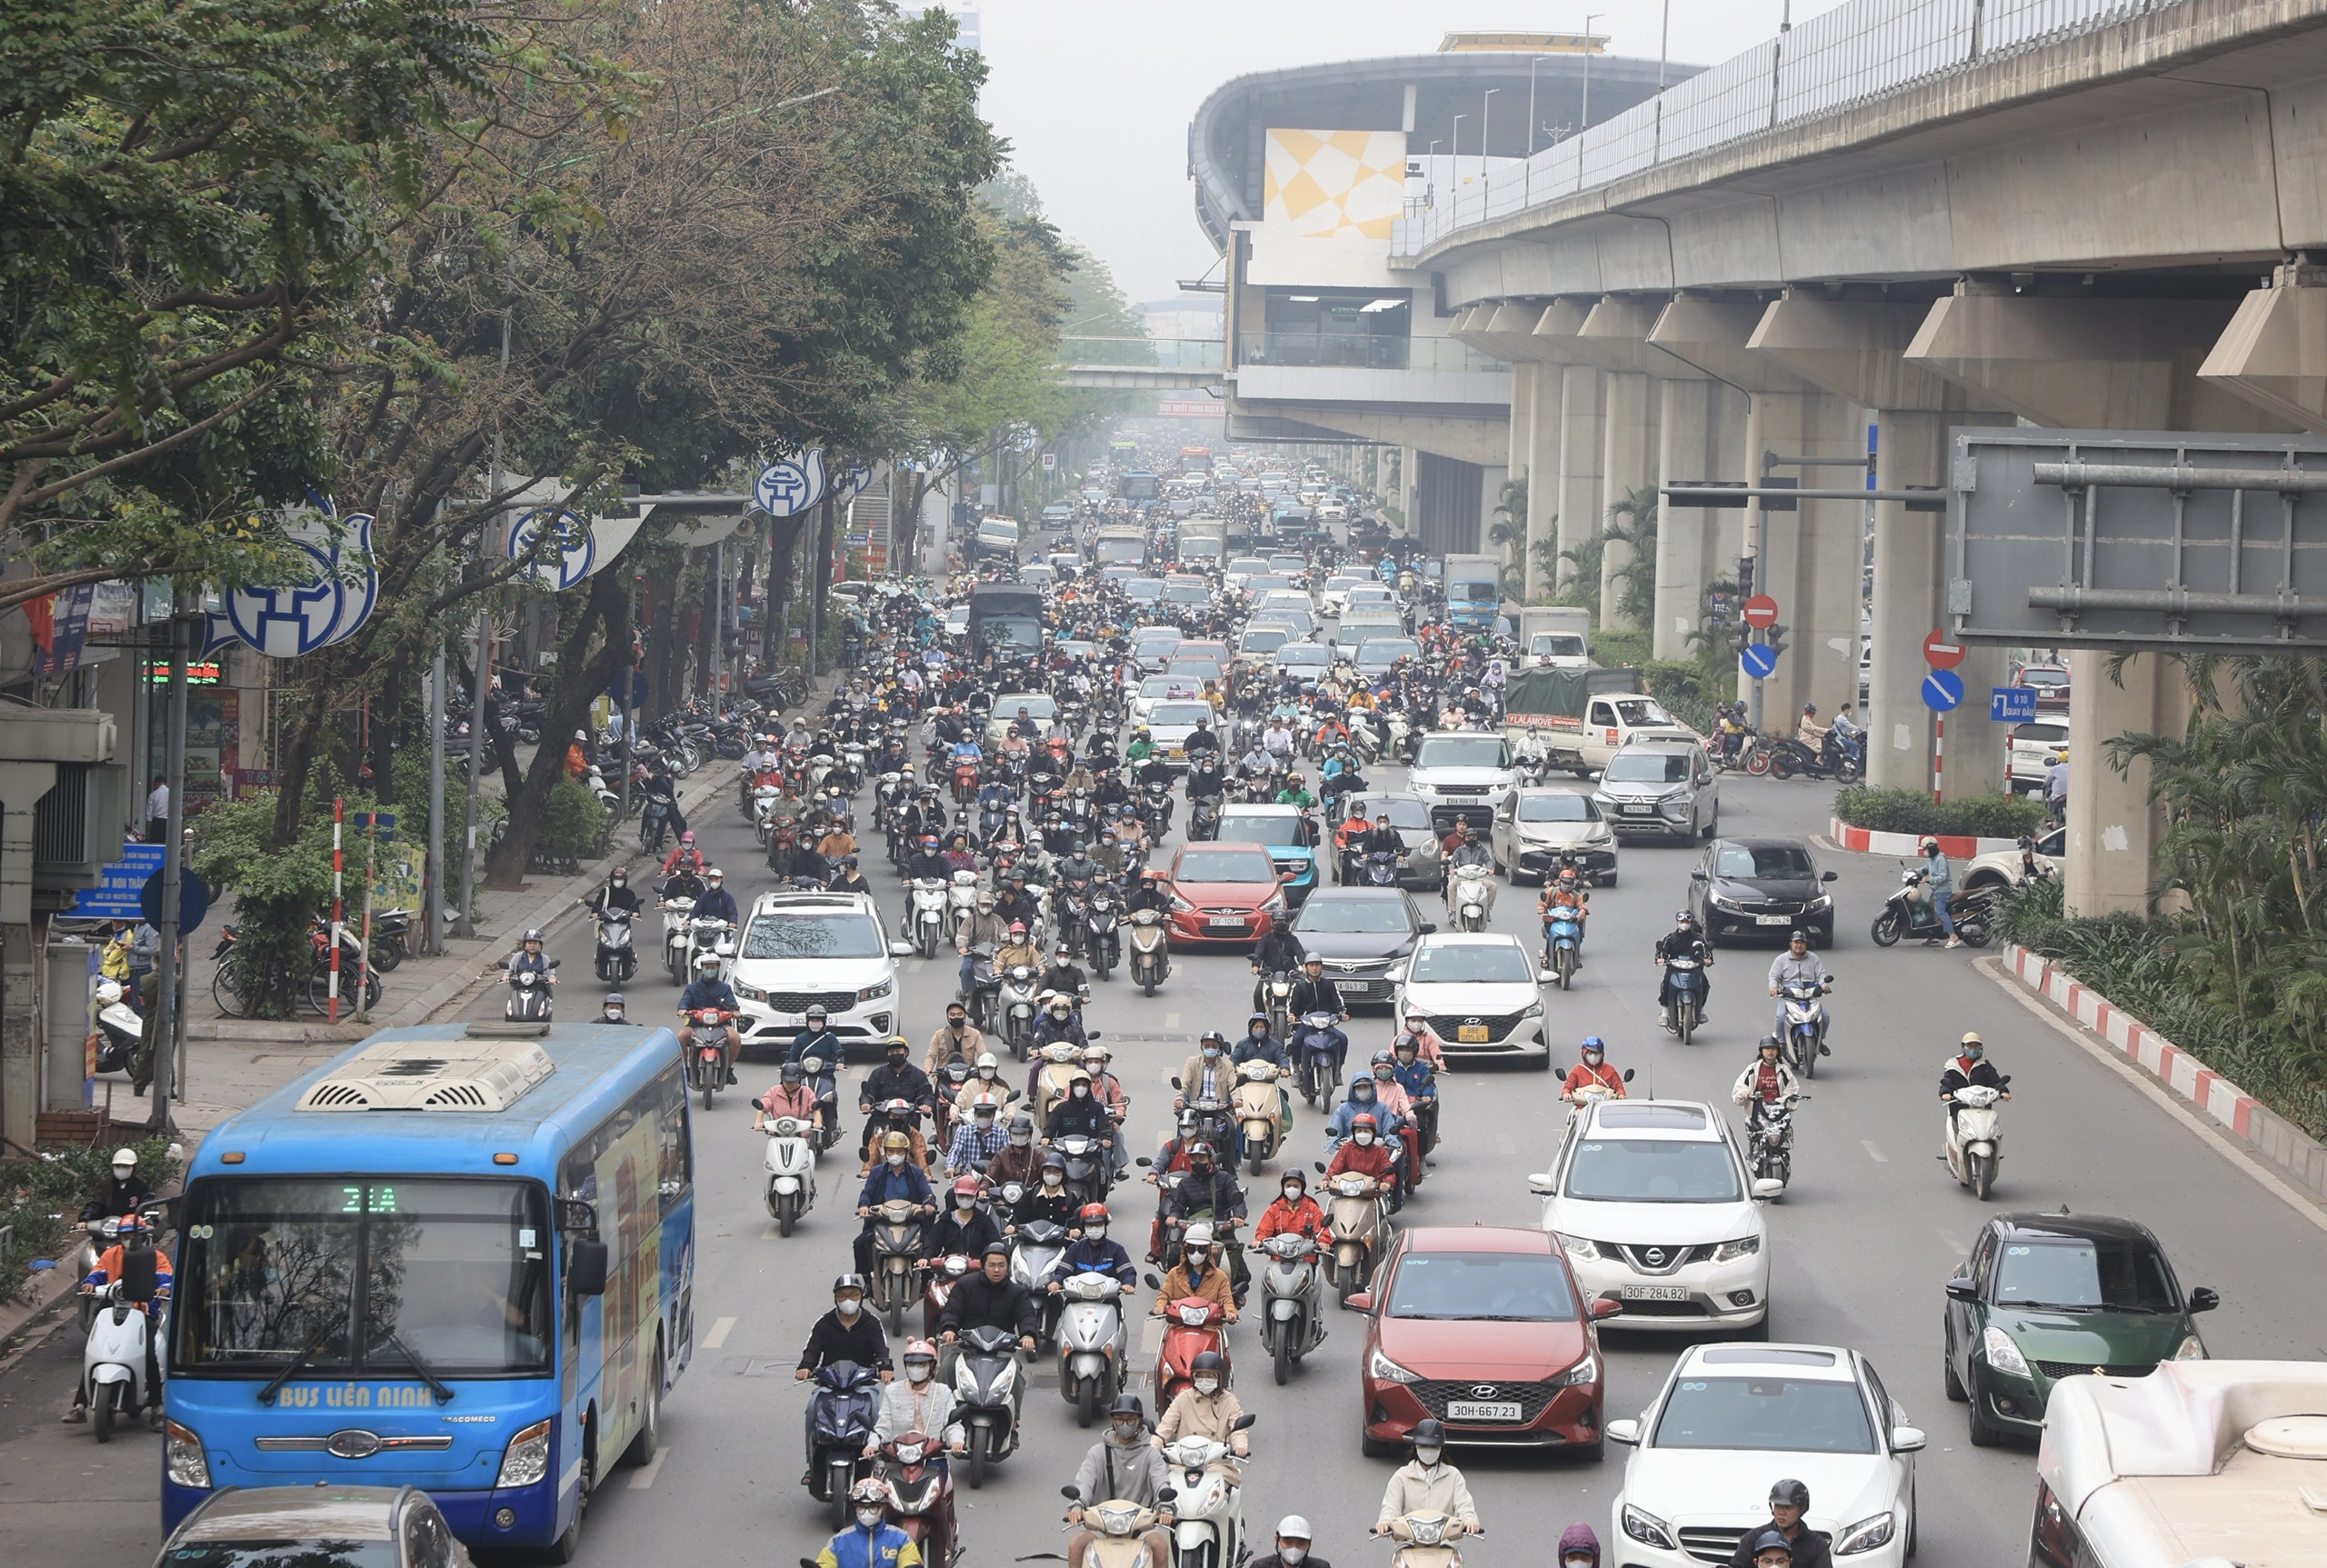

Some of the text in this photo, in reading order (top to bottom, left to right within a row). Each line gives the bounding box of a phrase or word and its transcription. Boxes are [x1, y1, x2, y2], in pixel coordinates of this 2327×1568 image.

[2014, 694, 2028, 704] Ô TÔ
[2006, 704, 2034, 716] QUAY ĐẦU
[1513, 714, 1553, 726] LALAMOVE
[245, 771, 255, 783] T
[257, 771, 267, 783] &
[112, 877, 126, 889] NON
[1627, 1286, 1683, 1300] 30F-284.82
[280, 1382, 432, 1407] BUS LIÊN NINH
[1453, 1405, 1516, 1417] 30H-667.23
[882, 1545, 898, 1560] be
